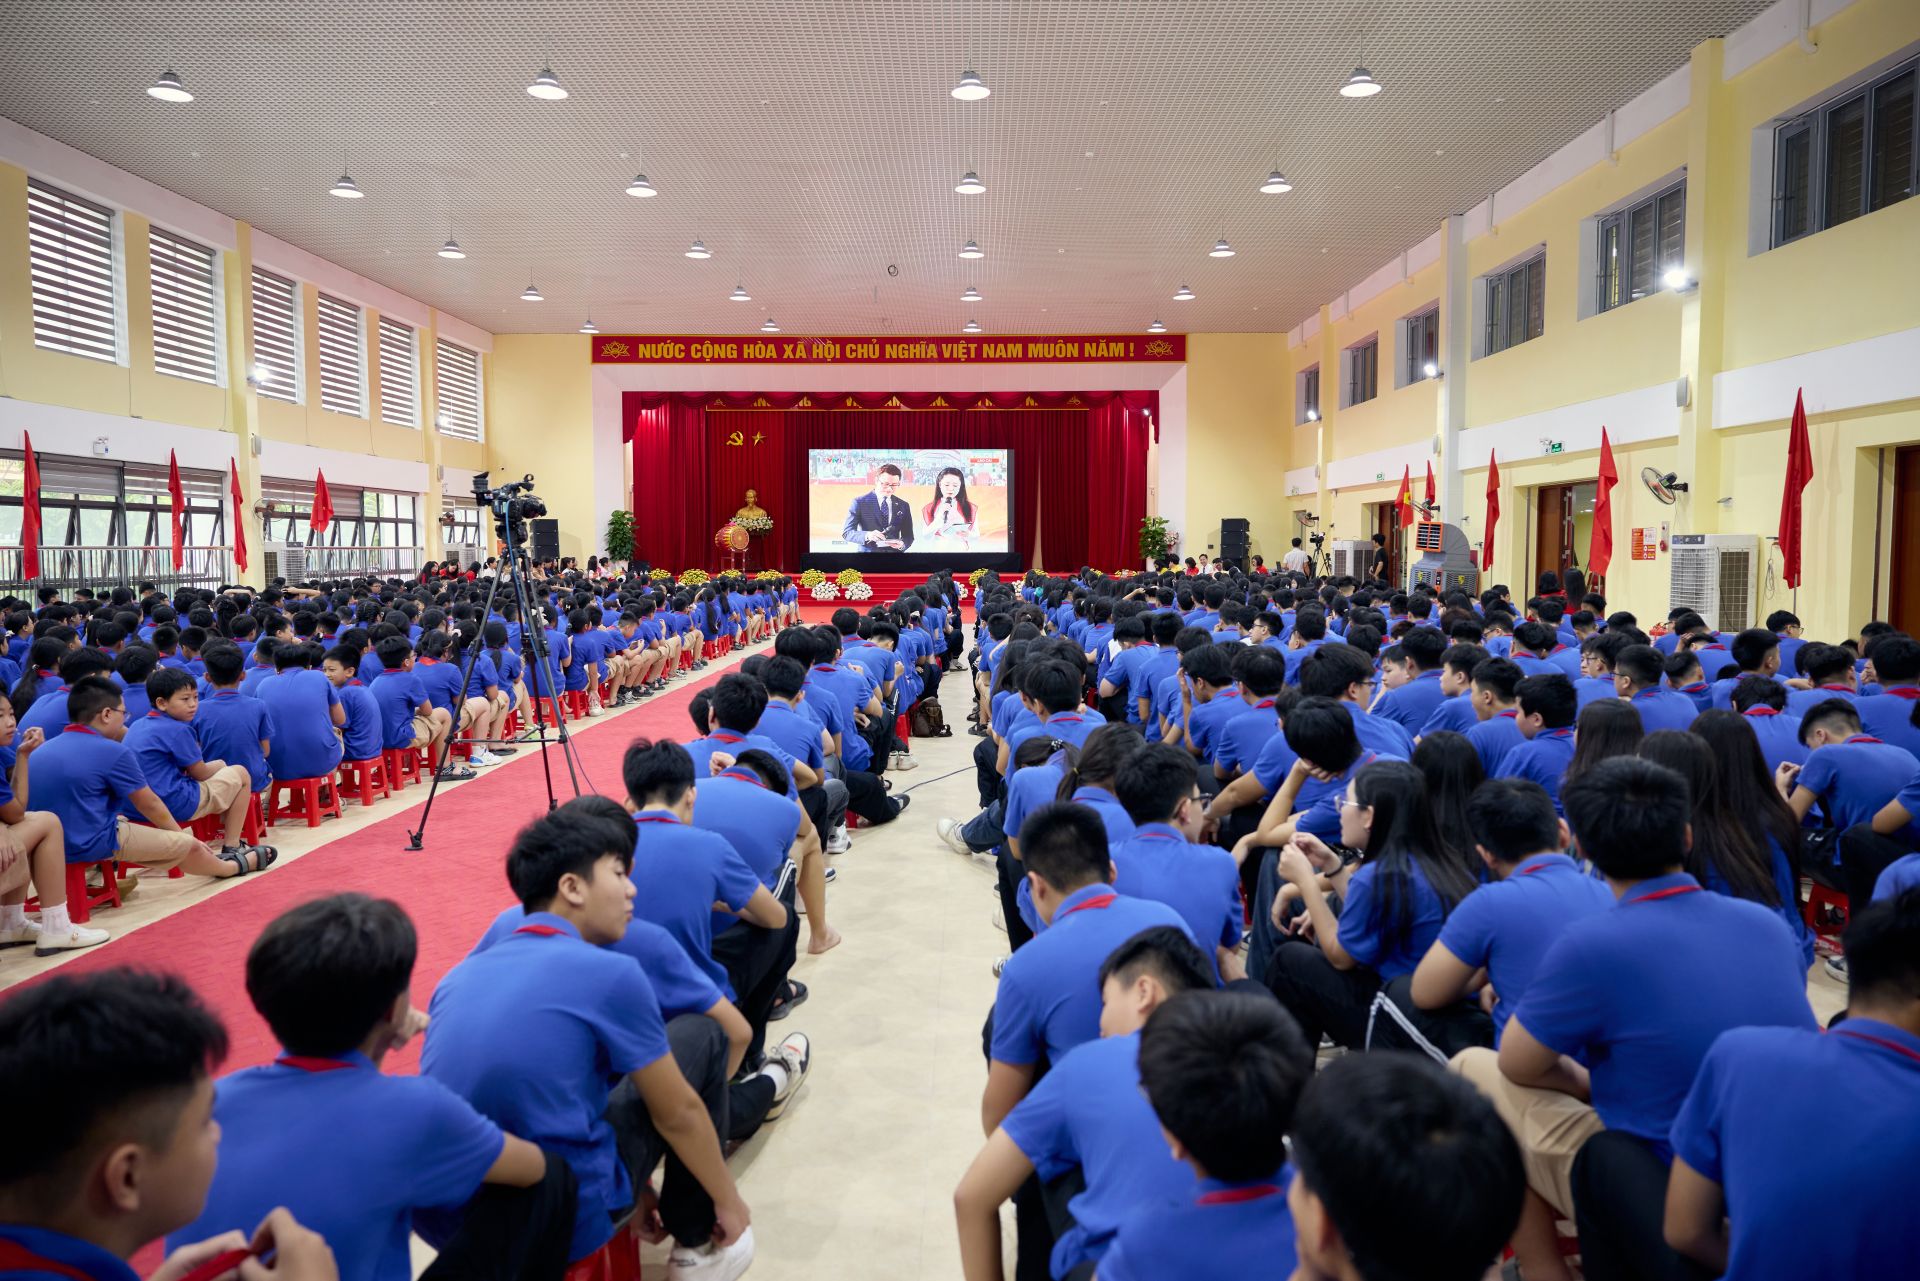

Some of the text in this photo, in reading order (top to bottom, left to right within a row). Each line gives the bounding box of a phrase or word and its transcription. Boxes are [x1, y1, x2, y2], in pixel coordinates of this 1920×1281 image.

[638, 340, 686, 358] NƯỚC
[691, 341, 738, 361] CỘNG
[743, 341, 778, 358] HÒA
[783, 340, 807, 358] XÃ
[812, 339, 841, 361] HỘI
[845, 339, 880, 358] CHỦ
[885, 340, 938, 358] NGHĨA
[942, 341, 978, 361] VIỆT
[983, 344, 1023, 358] NAM
[1027, 340, 1079, 358] MUÔN
[1084, 340, 1125, 358] NĂM
